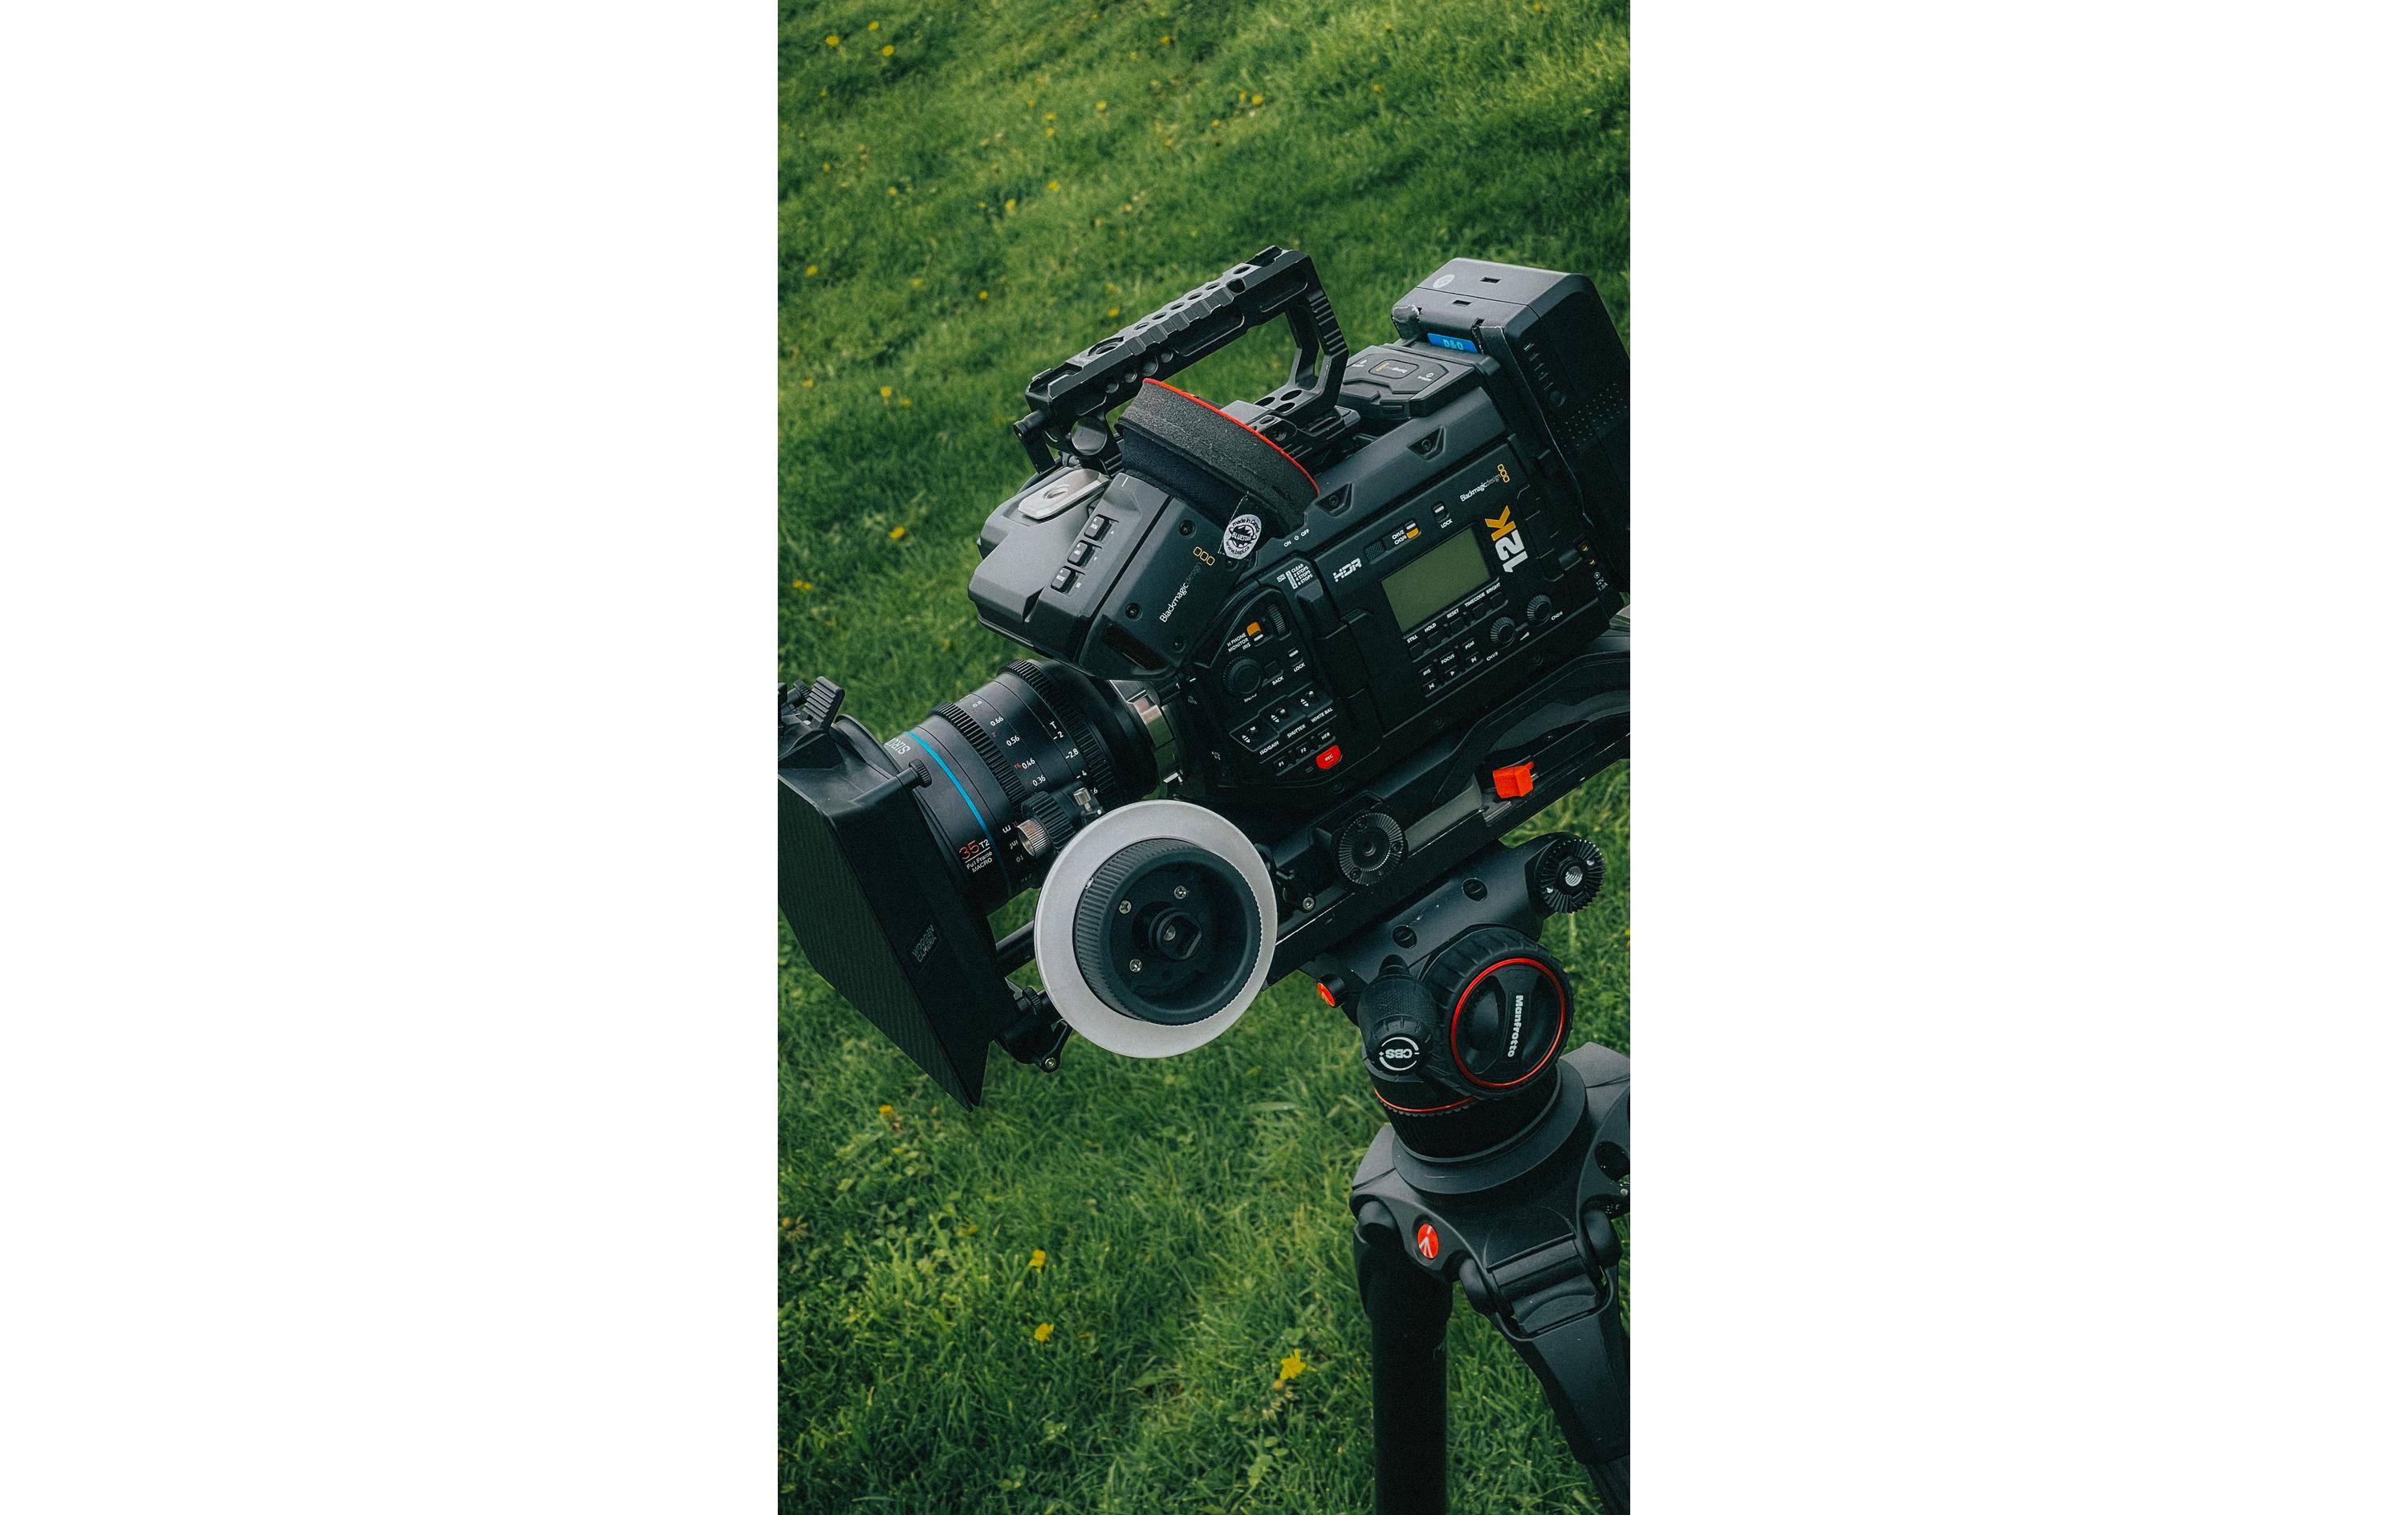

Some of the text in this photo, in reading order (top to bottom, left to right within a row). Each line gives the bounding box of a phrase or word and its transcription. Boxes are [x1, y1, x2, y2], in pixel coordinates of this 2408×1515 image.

[1440, 518, 1453, 529] LOCK
[1300, 528, 1310, 537] OFF
[1485, 505, 1528, 573] 12K
[1291, 563, 1304, 573] CLEAR
[1296, 565, 1309, 575] STOPS
[1332, 558, 1362, 583] HDR
[1298, 569, 1312, 579] STOPS
[1300, 573, 1313, 584] STOPS
[1159, 562, 1202, 623] Blackmagicdesign
[1464, 591, 1486, 607] TIMECODE
[1446, 608, 1460, 619] RESET
[1424, 623, 1437, 632] HOLD
[1231, 632, 1247, 644] PHONE
[1406, 635, 1418, 644] STILL
[1228, 638, 1250, 653] MONITOR
[1243, 643, 1251, 651] IRIS
[1441, 653, 1455, 664] FOCUS
[1293, 662, 1306, 672] LOCK
[1271, 676, 1284, 686] BACK
[1311, 707, 1333, 724] WHITE BAL
[990, 716, 1004, 727] 0.66
[1049, 721, 1057, 729] T
[1287, 724, 1307, 738] SHUTTER
[1321, 732, 1331, 741] HFR
[1006, 734, 1020, 746] 0.56
[1259, 740, 1279, 756] ISO/GAIN
[1324, 753, 1334, 762] REC
[1021, 758, 1035, 770] 0.46
[1032, 774, 1046, 787] 0.36
[958, 839, 990, 861] 35 T2
[966, 851, 993, 870] Full Frame
[971, 857, 993, 873] MACRO
[1507, 994, 1524, 1058] Manfrotto
[1385, 1048, 1413, 1059] CBS
